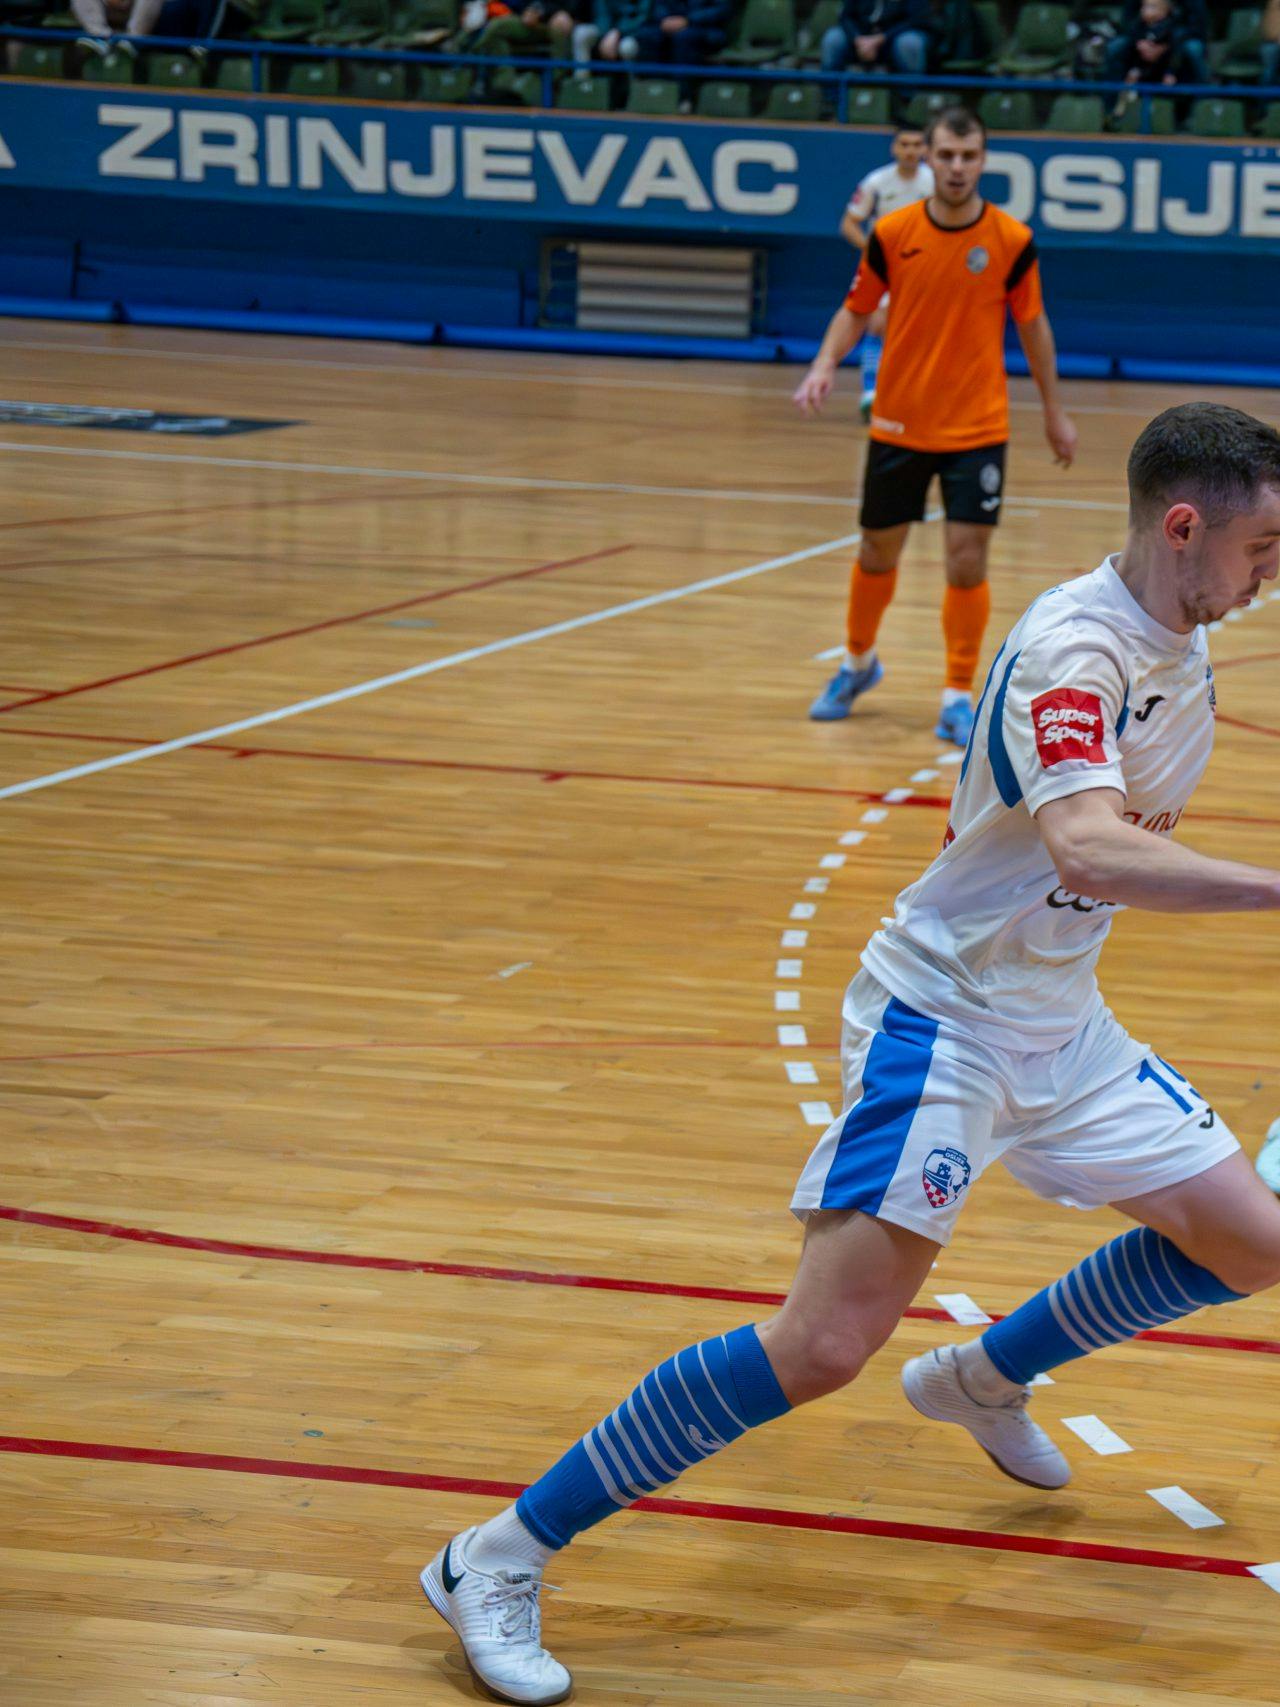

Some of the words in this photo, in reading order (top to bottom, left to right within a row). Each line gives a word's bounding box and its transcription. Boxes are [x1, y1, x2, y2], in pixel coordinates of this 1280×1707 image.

[98, 103, 799, 216] ZRINJEVAC
[1038, 707, 1099, 729] Super
[1042, 724, 1095, 747] Sport
